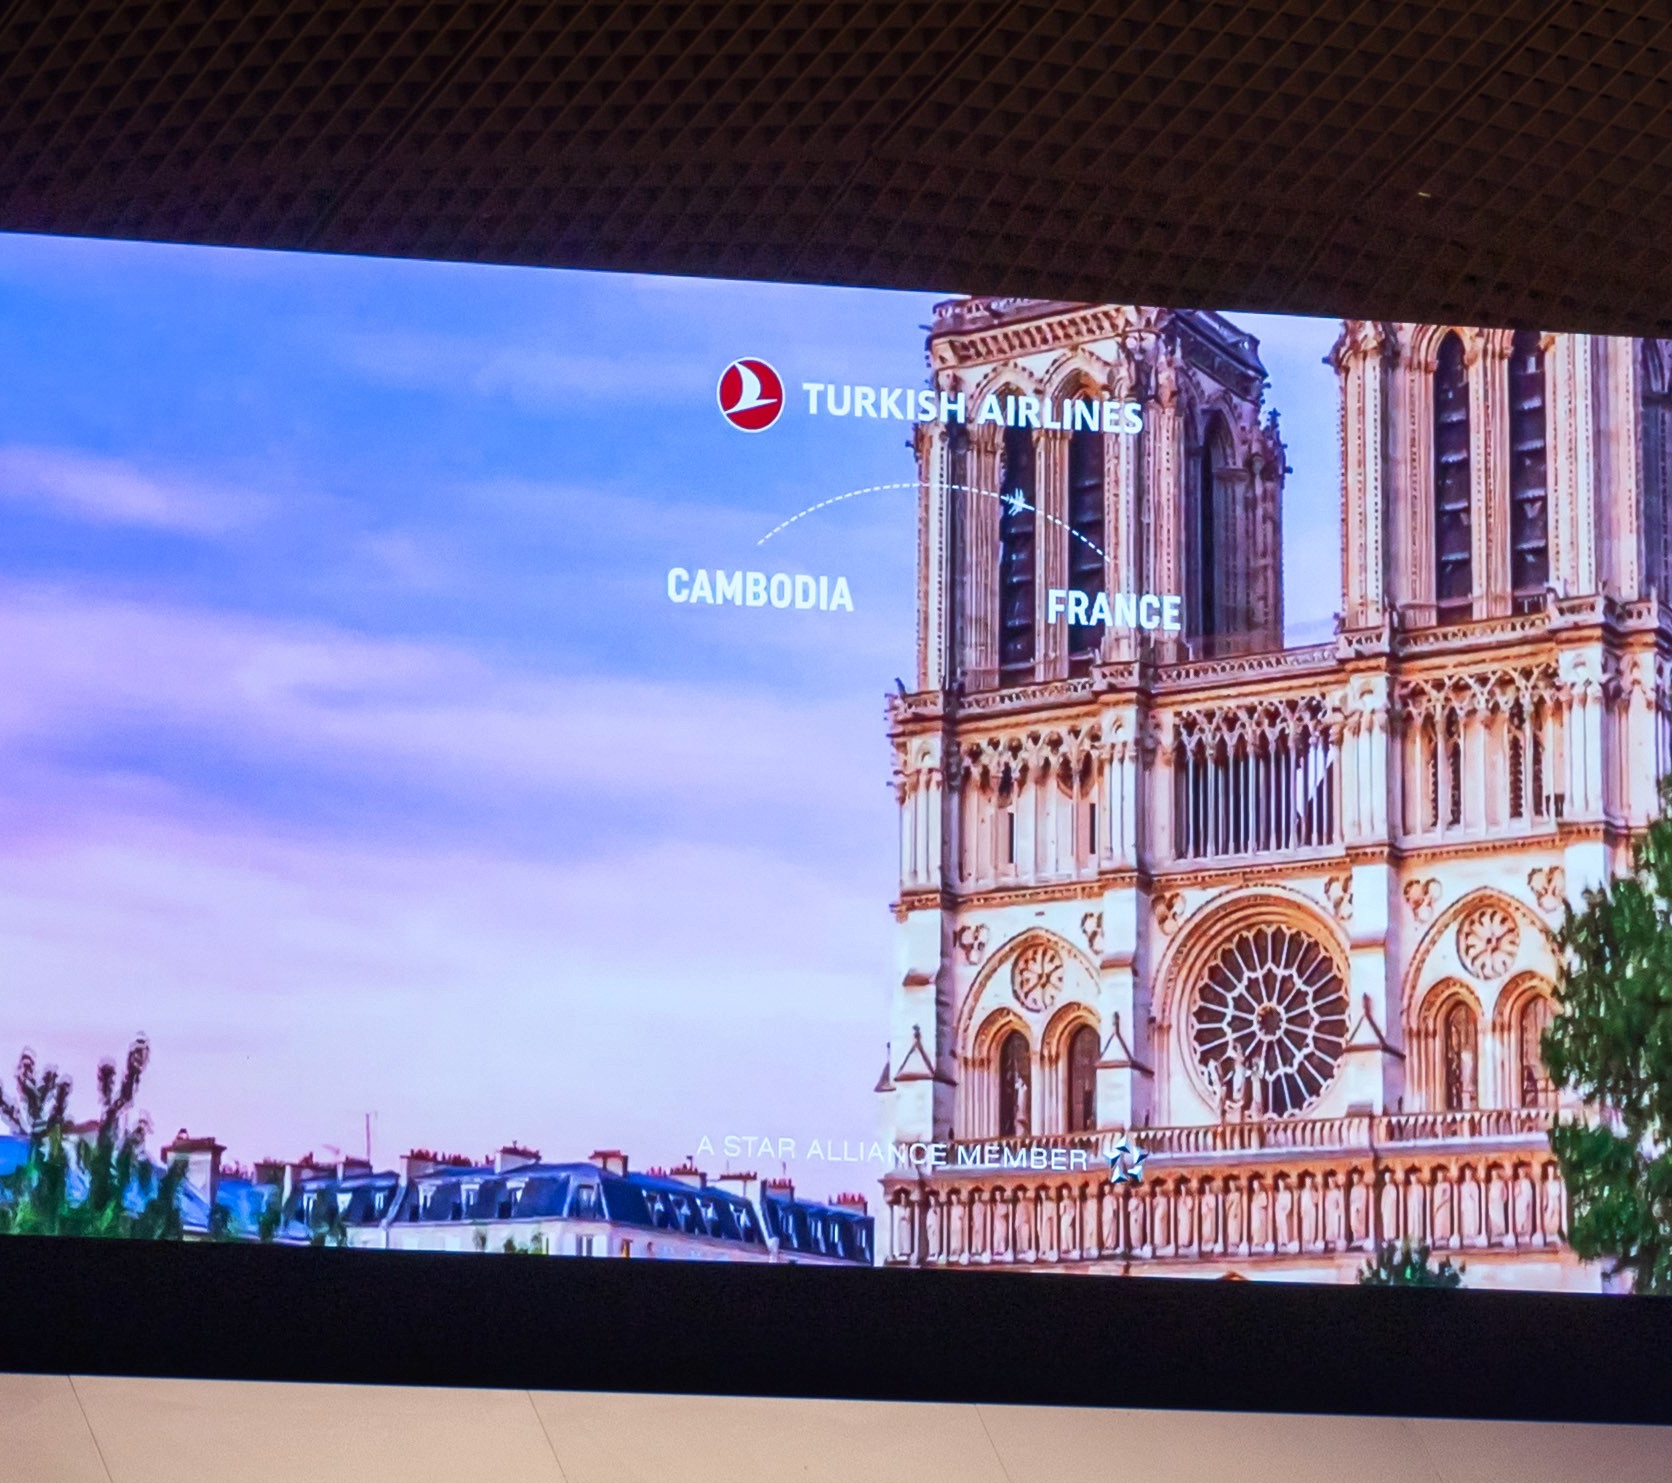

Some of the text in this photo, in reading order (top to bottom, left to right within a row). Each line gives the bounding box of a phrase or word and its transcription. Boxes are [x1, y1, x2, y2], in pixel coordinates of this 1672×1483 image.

[803, 382, 1143, 435] TURKISH AIRLINES
[667, 567, 854, 612] CAMBODIA
[1047, 588, 1182, 632] FRANCE
[696, 1136, 1088, 1172] A STAR ALLIANCE MEMBER
